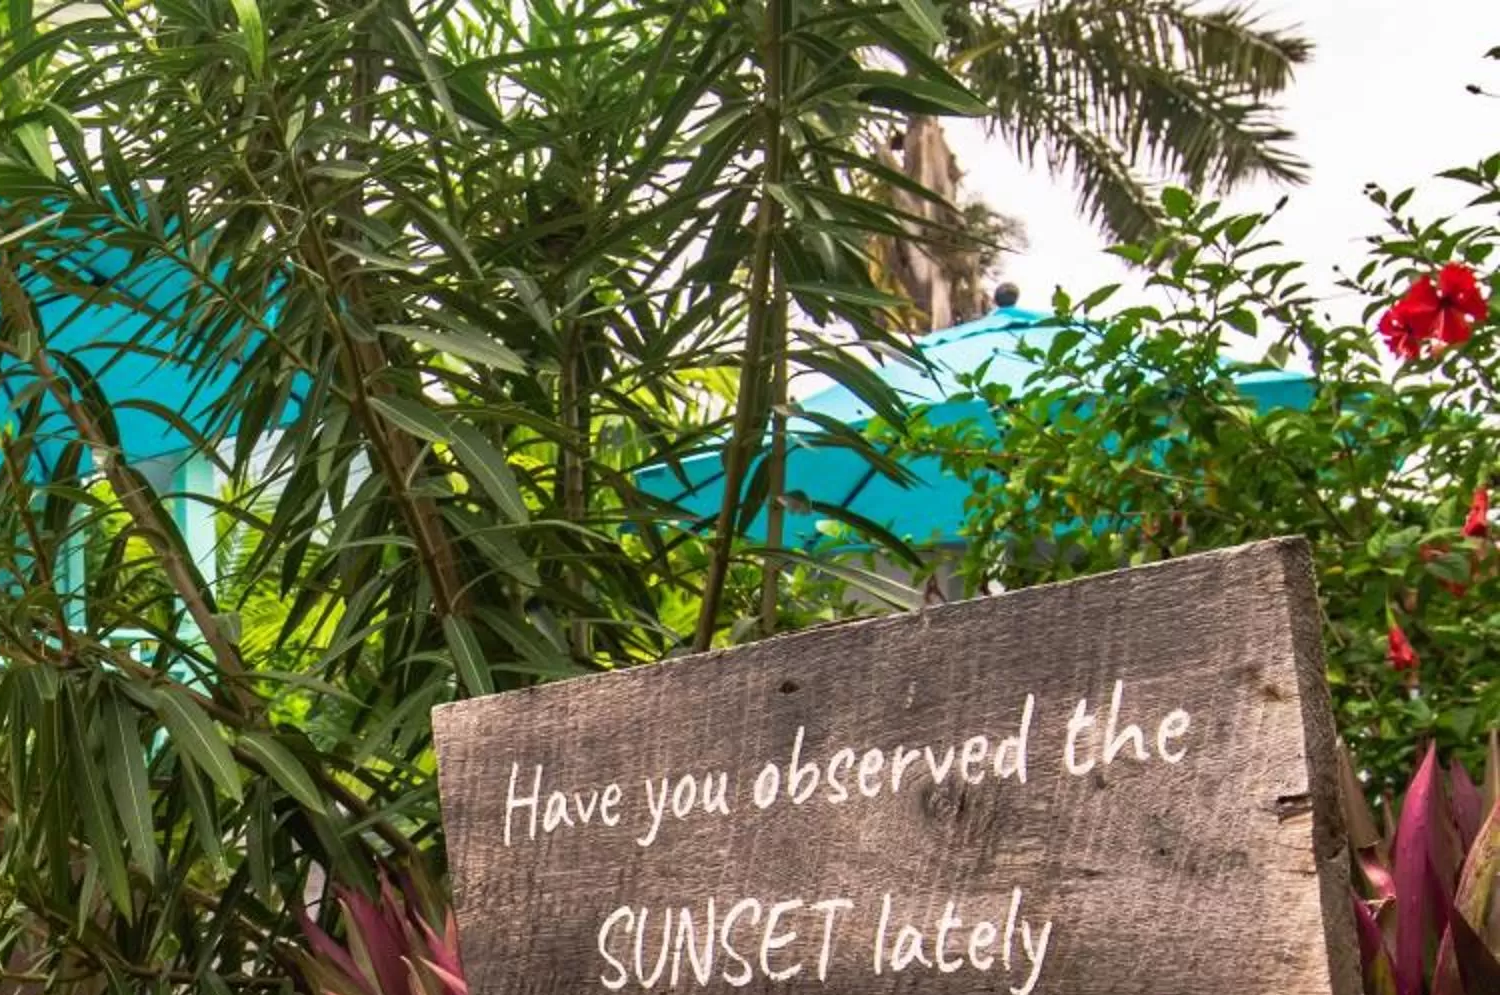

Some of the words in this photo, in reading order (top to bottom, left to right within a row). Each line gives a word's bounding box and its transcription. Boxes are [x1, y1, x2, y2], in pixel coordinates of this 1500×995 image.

[503, 761, 623, 847] Have
[636, 771, 731, 847] you
[752, 692, 1036, 810] observed
[1063, 678, 1192, 776] the
[597, 896, 855, 990] SUNSET
